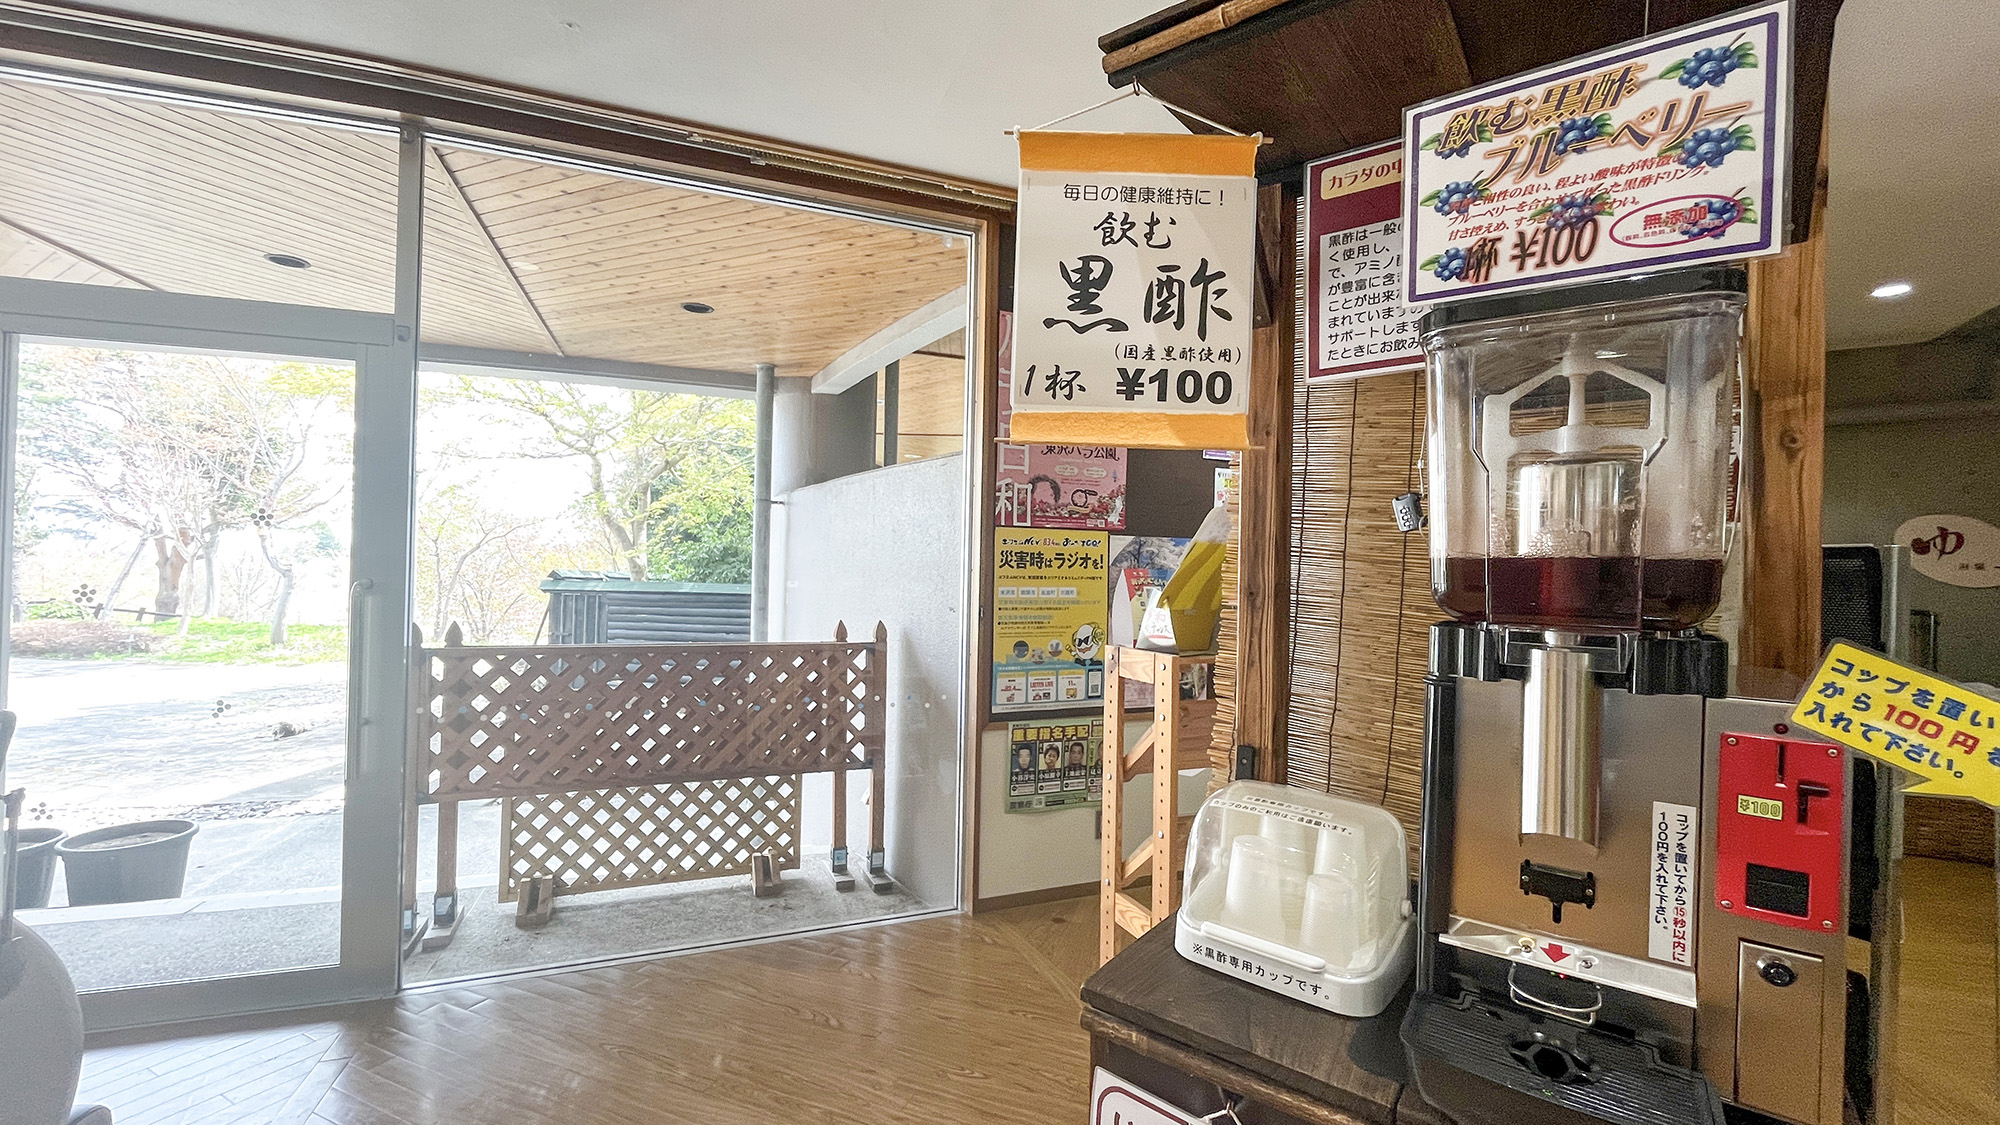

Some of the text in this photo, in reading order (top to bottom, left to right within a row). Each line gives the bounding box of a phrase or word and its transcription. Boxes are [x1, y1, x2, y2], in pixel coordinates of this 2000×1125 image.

[1440, 62, 1646, 151] 飲む黒酢
[1479, 94, 1752, 189] ブルーベリー
[1063, 184, 1226, 206] 毎日の健康維持に!
[1094, 211, 1177, 249] 飲む
[1643, 205, 1709, 232] 無添加
[1328, 243, 1390, 263] く使用し、
[1510, 217, 1600, 272] ¥100
[1043, 255, 1233, 341] 黒酢
[1328, 272, 1401, 296] が豊富に含
[1115, 343, 1242, 364] (国産黒酢使用)
[1327, 336, 1420, 362] たときにお飲み
[1024, 364, 1233, 404] 1杯 ¥100
[999, 550, 1104, 570] 災害時はラジオを!
[1830, 657, 1995, 730] コップを置い
[1804, 700, 1964, 779] 入れて下さい。
[1739, 798, 1781, 818] ¥100
[1654, 811, 1669, 931] 100円を入れて下さい。
[1192, 943, 1330, 1001] ※黒酢専用カップです。
